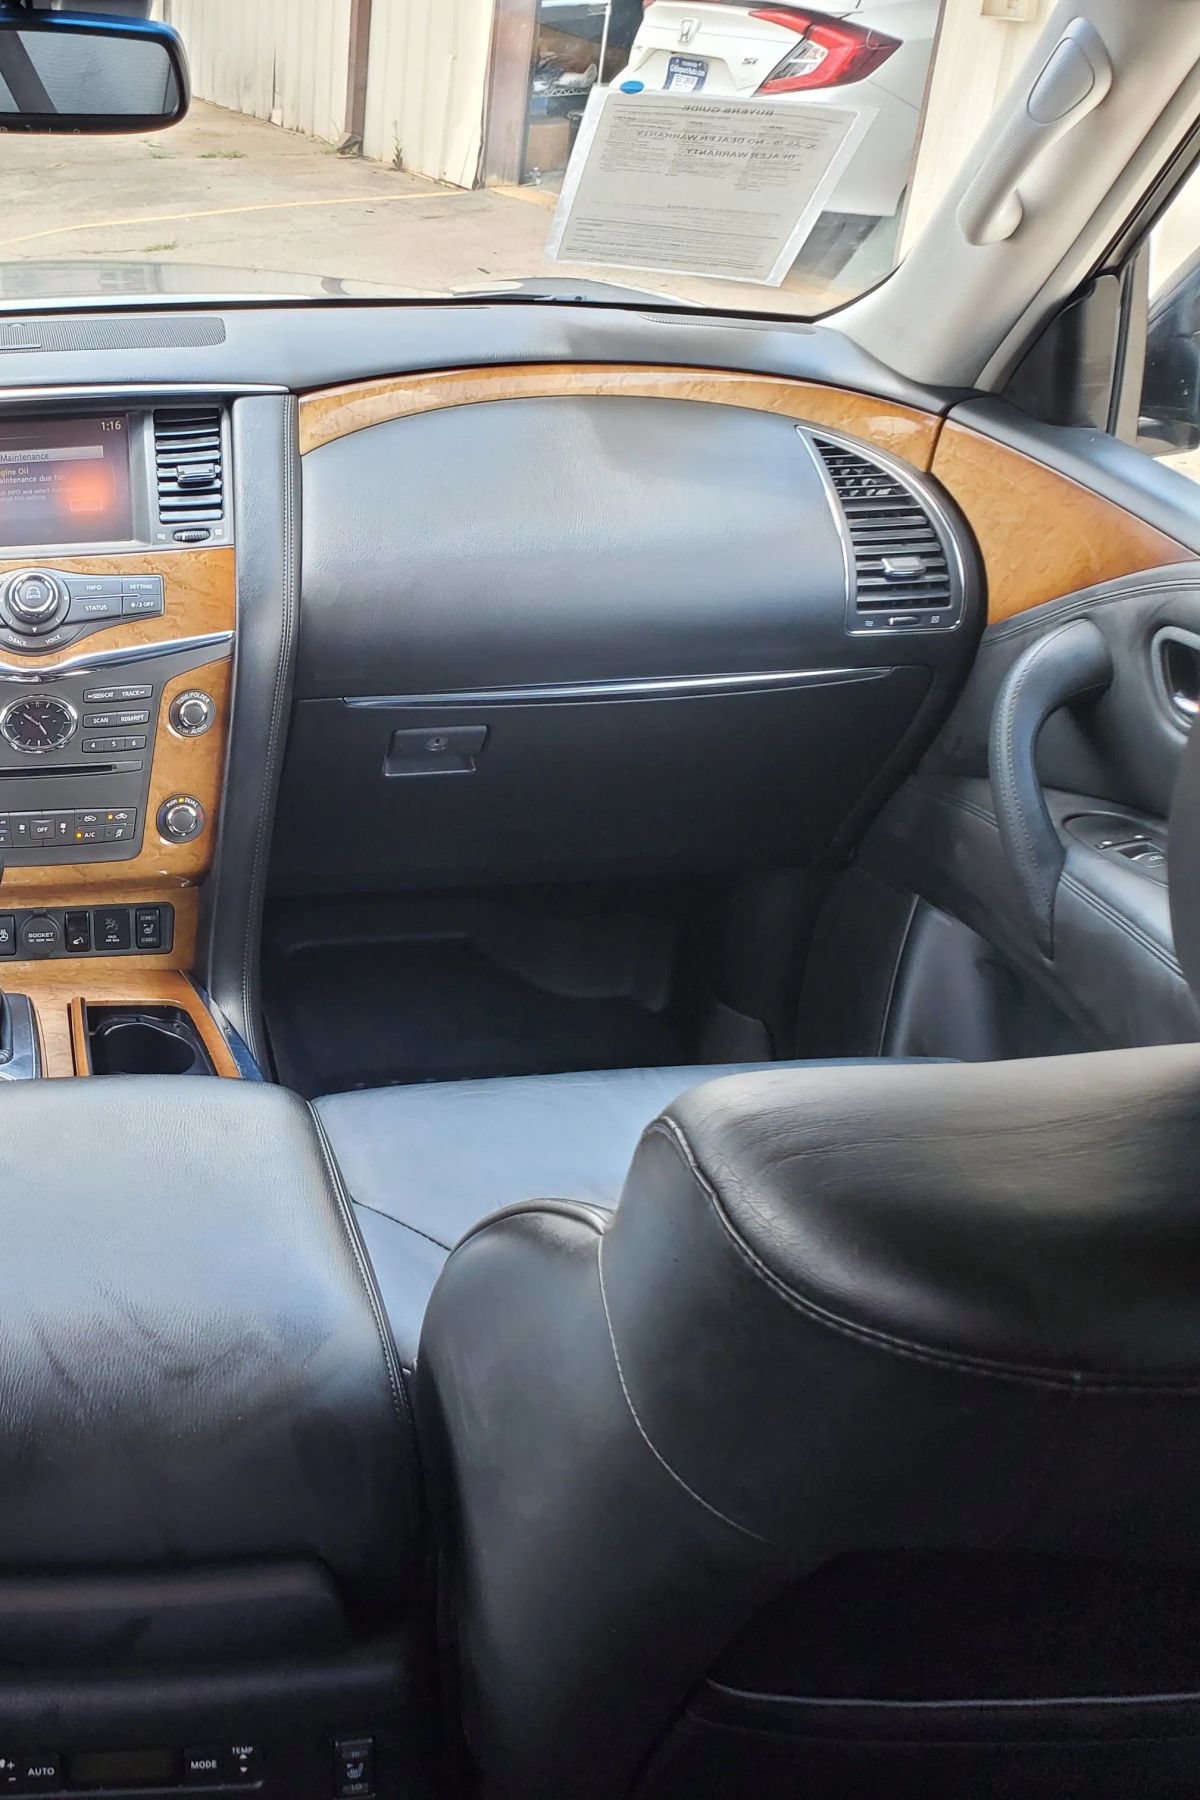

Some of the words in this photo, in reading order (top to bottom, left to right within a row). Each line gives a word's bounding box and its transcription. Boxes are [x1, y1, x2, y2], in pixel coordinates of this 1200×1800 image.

[100, 420, 122, 431] 1:16
[0, 452, 50, 462] Maintenance
[18, 467, 29, 475] Oil
[39, 474, 52, 482] due
[85, 604, 108, 612] STATUS
[45, 634, 62, 645] VOICE
[190, 723, 208, 734] AUDIO
[28, 931, 54, 939] SOCKET
[232, 1746, 254, 1755] TEMP
[190, 1759, 218, 1770] MODE
[27, 1767, 55, 1776] AUTO
